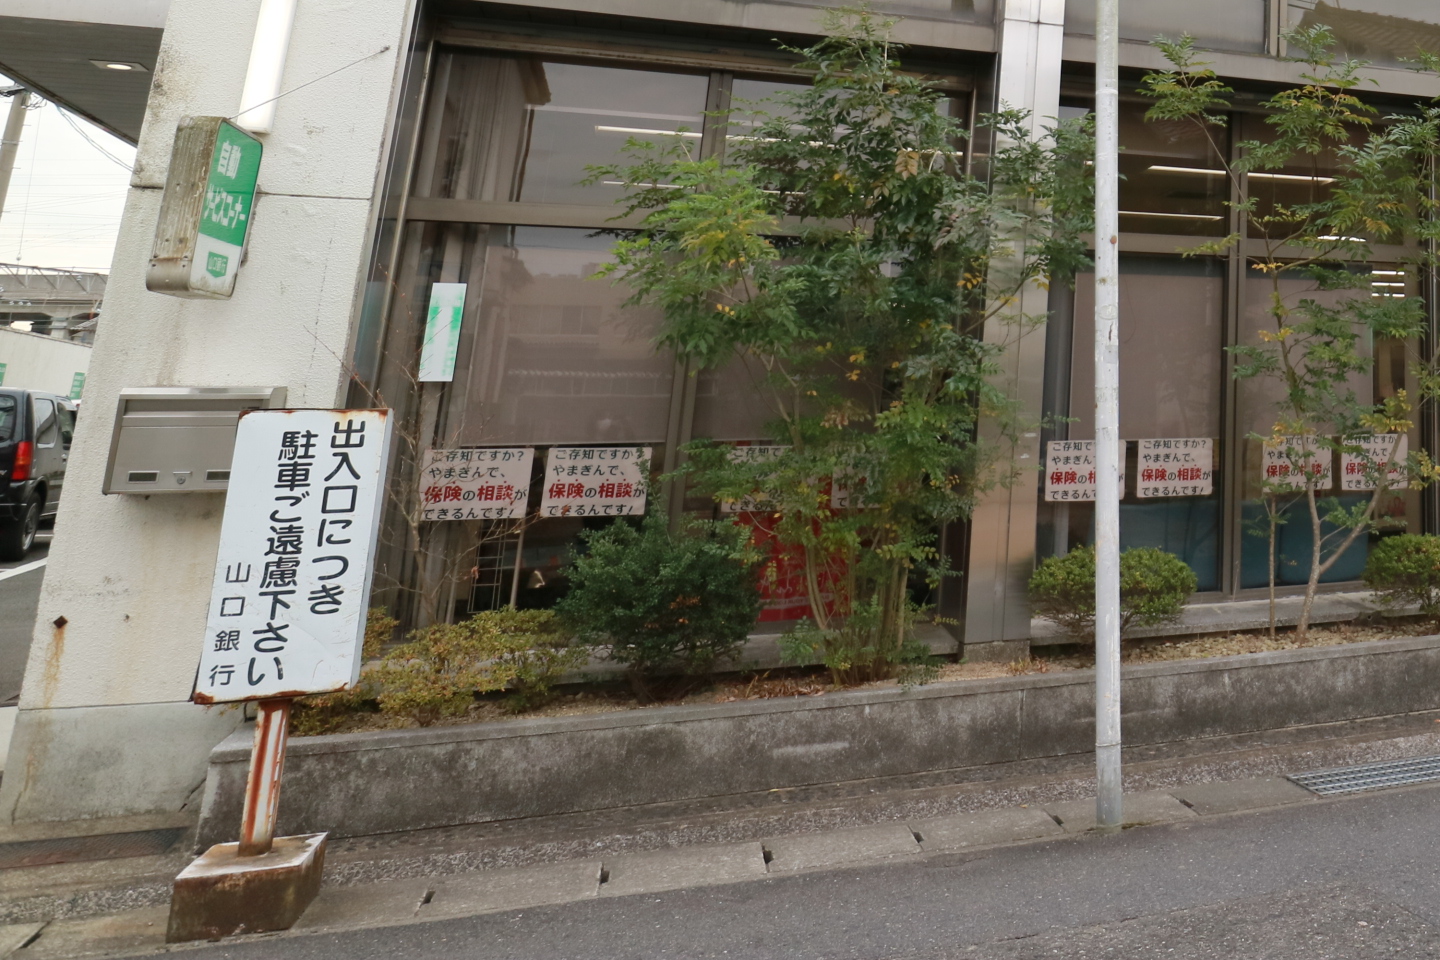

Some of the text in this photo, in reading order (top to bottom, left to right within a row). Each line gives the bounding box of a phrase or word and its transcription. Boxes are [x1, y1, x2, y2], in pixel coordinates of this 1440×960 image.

[217, 140, 242, 180] 自動
[203, 183, 246, 229] サービスコーナー
[1052, 441, 1096, 451] ご存知で
[1143, 440, 1206, 449] ご存知ですか?
[1051, 455, 1096, 465] やまぎん
[553, 465, 625, 476] やまぎんで、
[1141, 468, 1211, 482] 保険の相談が
[424, 485, 527, 502] 保険の相談が
[548, 483, 645, 499] 保険の相談が
[307, 419, 366, 615] 出入口につき
[247, 429, 319, 686] 駐車ご遠慮下さい
[208, 561, 251, 687] 山口銀行
